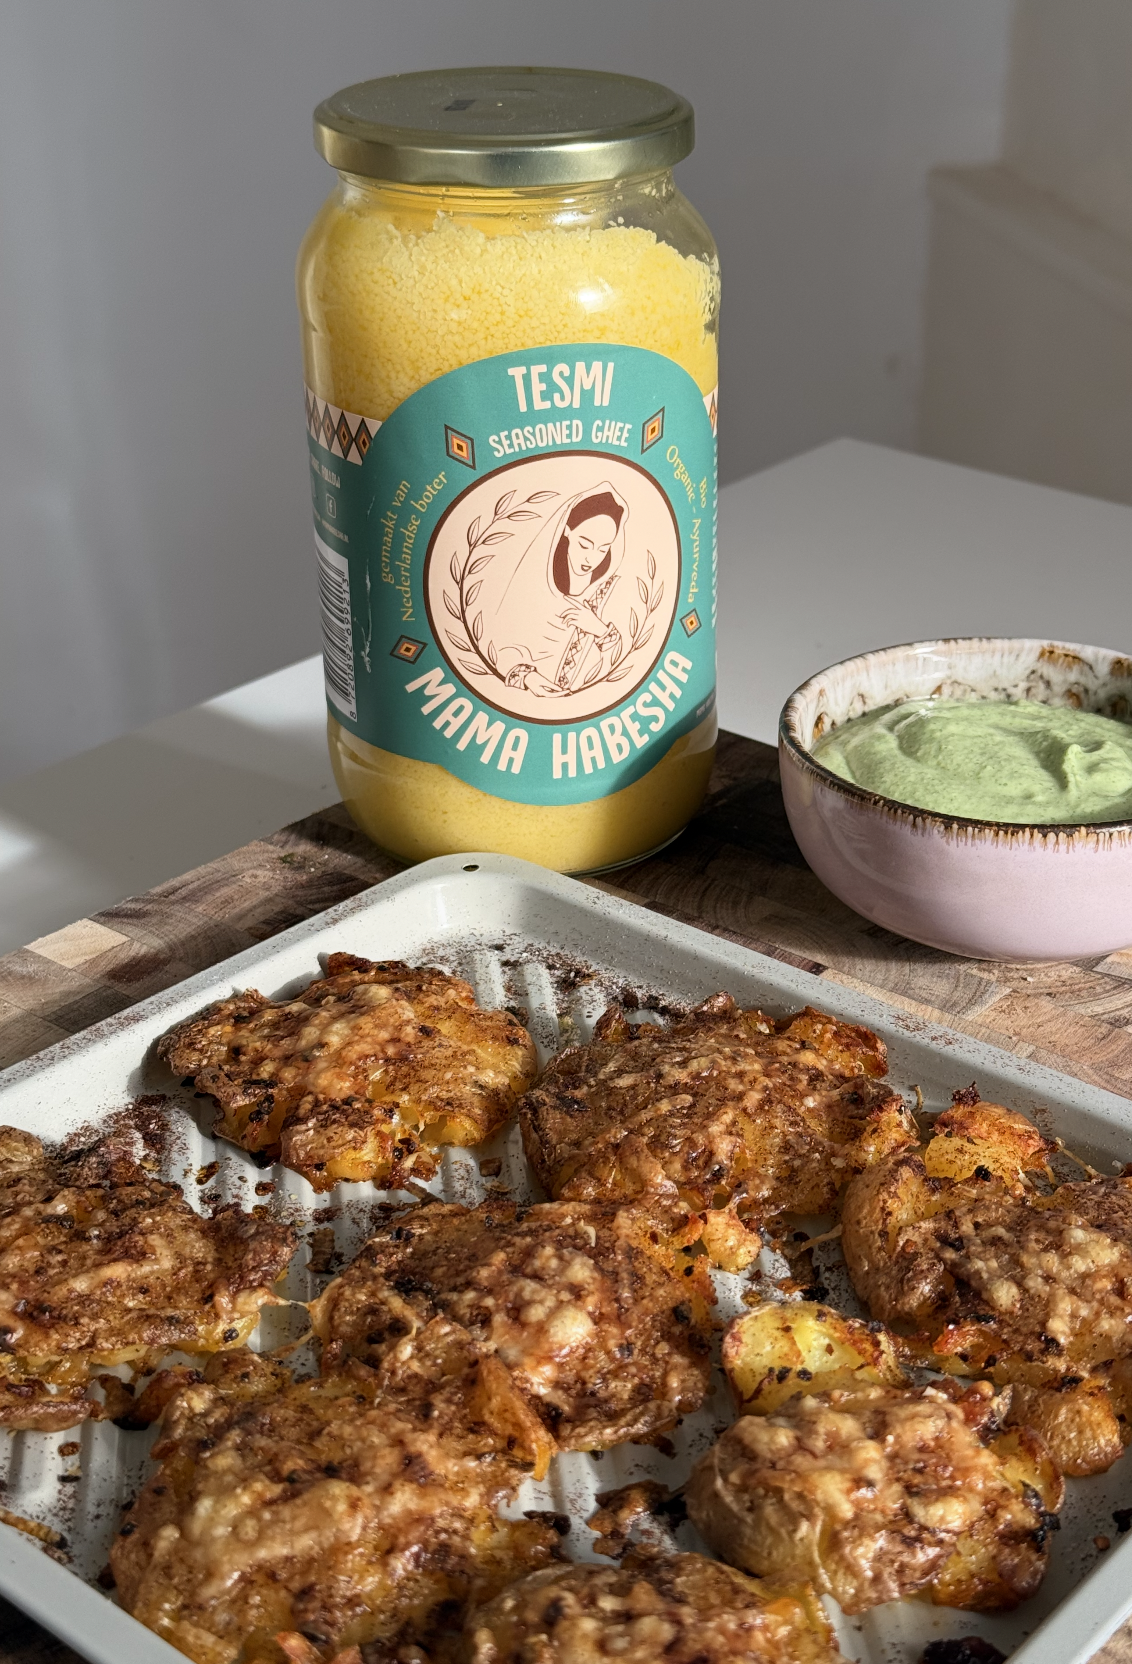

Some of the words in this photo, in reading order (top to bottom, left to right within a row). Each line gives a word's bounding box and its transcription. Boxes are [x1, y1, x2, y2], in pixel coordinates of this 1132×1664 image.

[489, 422, 584, 458] SEASONED
[592, 420, 632, 448] GHEE
[508, 361, 615, 413] TESMI
[380, 510, 398, 585] gemaakt
[392, 480, 411, 507] van
[666, 445, 696, 504] Organic
[687, 518, 702, 603] Ayurveda
[699, 476, 708, 508] Bio
[395, 514, 421, 621] Nederlandse
[410, 471, 448, 513] boter
[405, 665, 529, 775] MAMA
[552, 650, 694, 779] HABESHA
